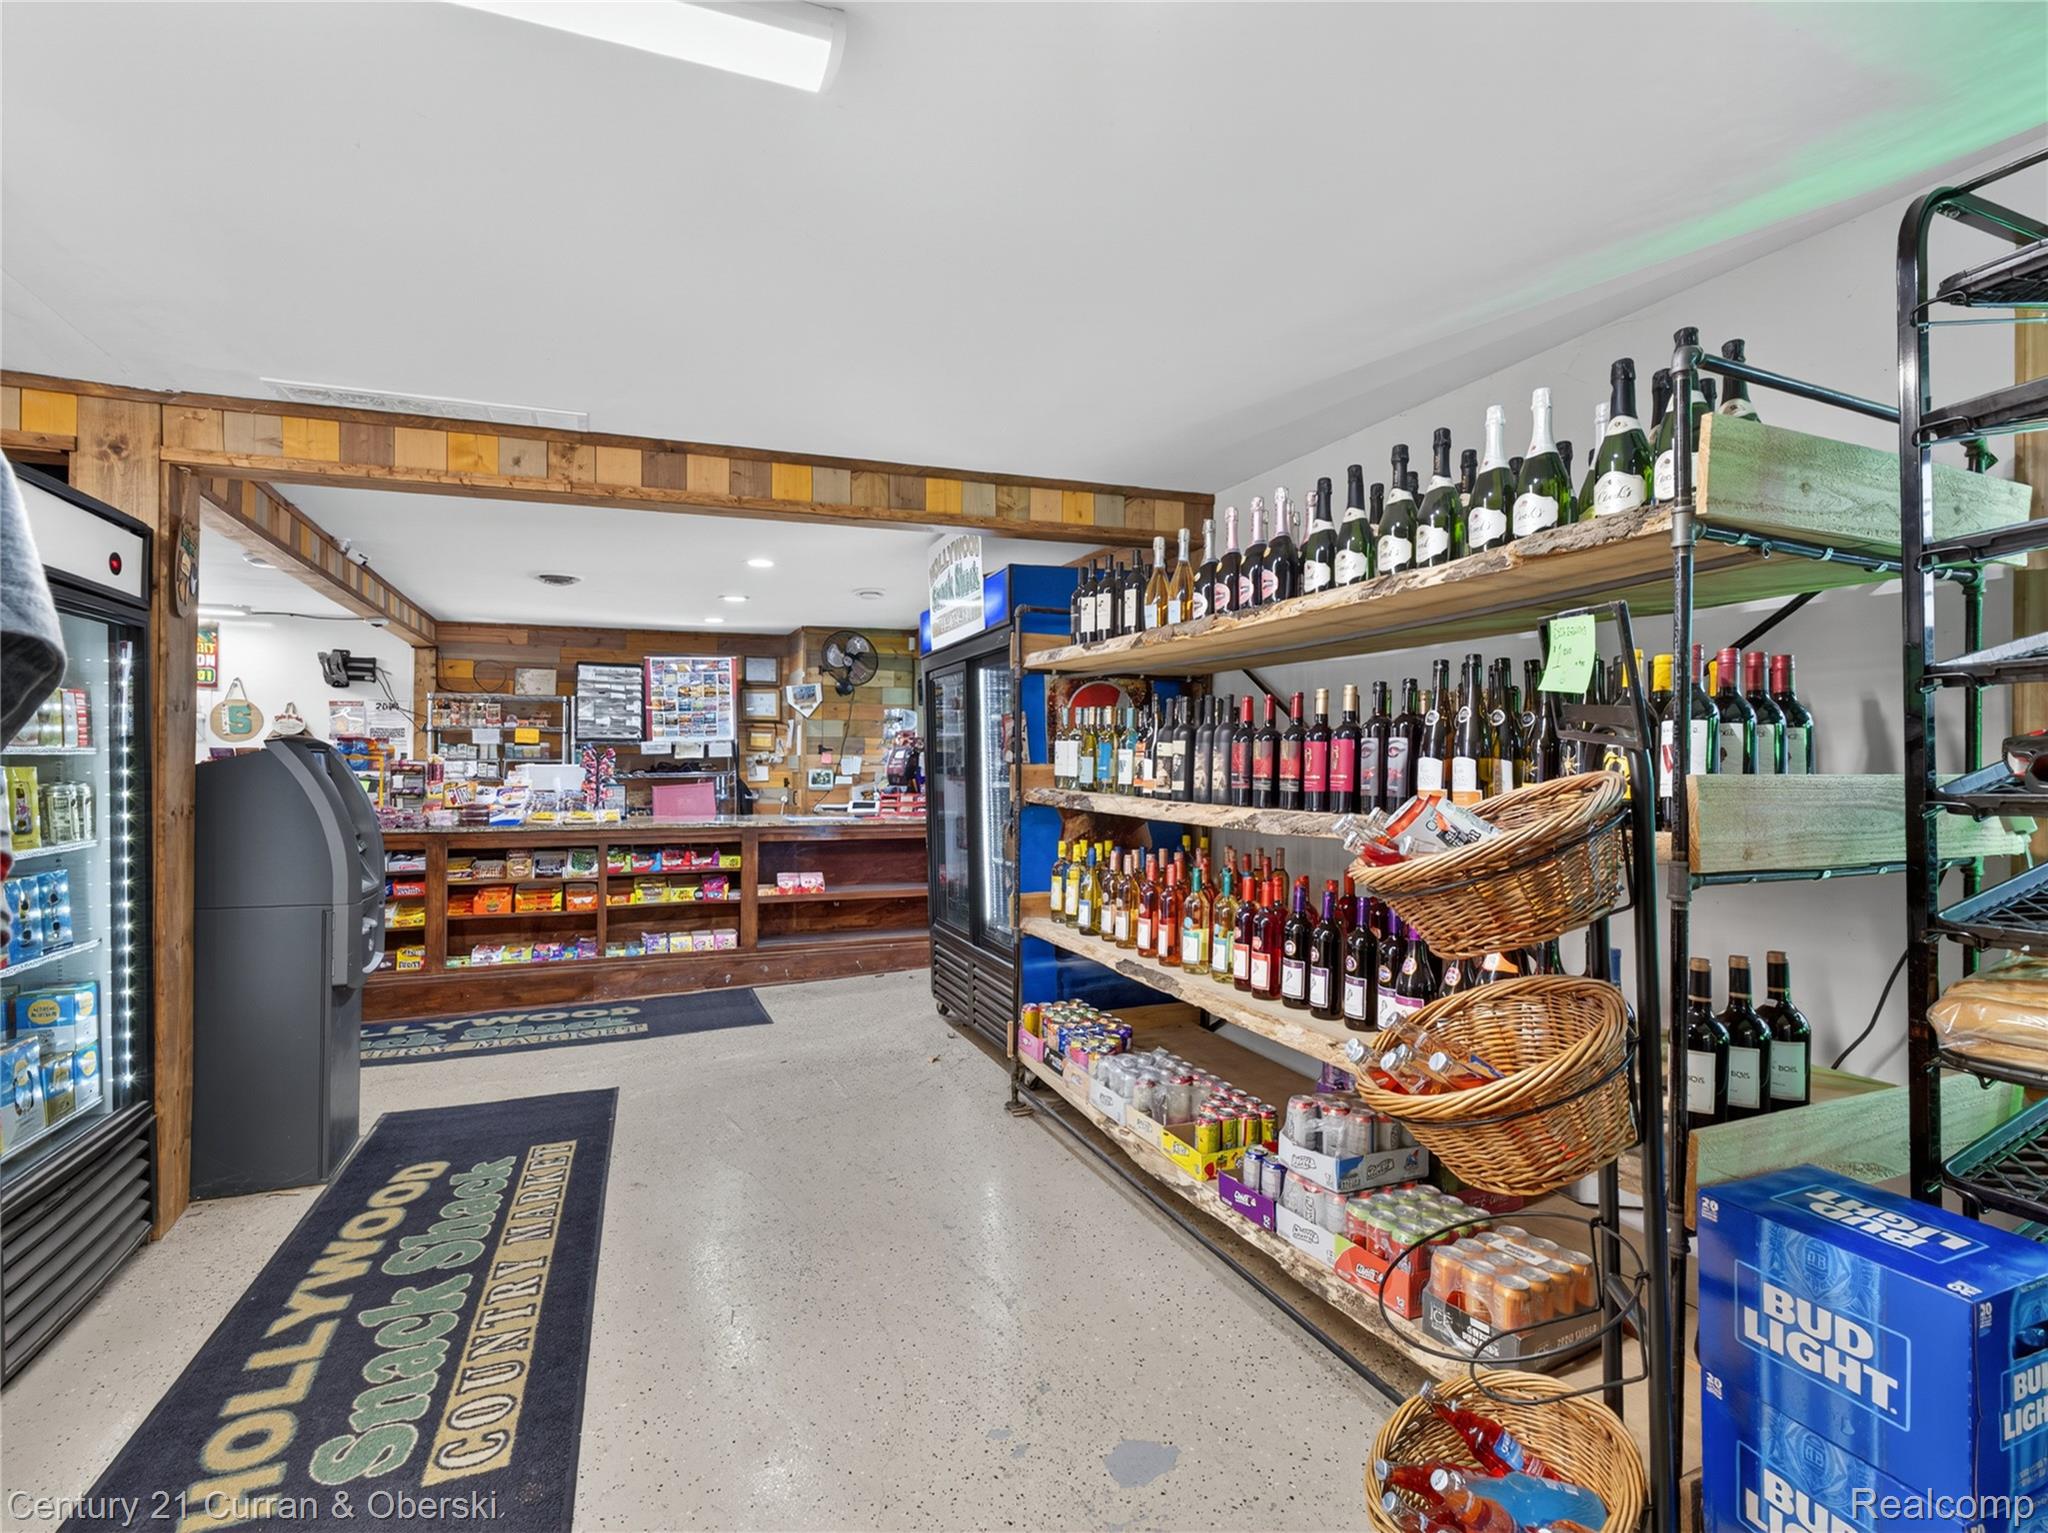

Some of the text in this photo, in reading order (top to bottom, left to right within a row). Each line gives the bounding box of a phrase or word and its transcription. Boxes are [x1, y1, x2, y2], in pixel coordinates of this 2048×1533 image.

[361, 1006, 641, 1038] LLYWOOD
[1805, 1190, 1973, 1251] LIGHT
[1808, 1200, 1929, 1248] BUD
[309, 1155, 517, 1486] Snack Shack
[434, 1143, 573, 1471] COUNTRY MARKET
[1763, 1281, 1874, 1360] BUD
[175, 1160, 451, 1533] HOLLYWOOD
[2003, 1395, 2048, 1441] LIGH
